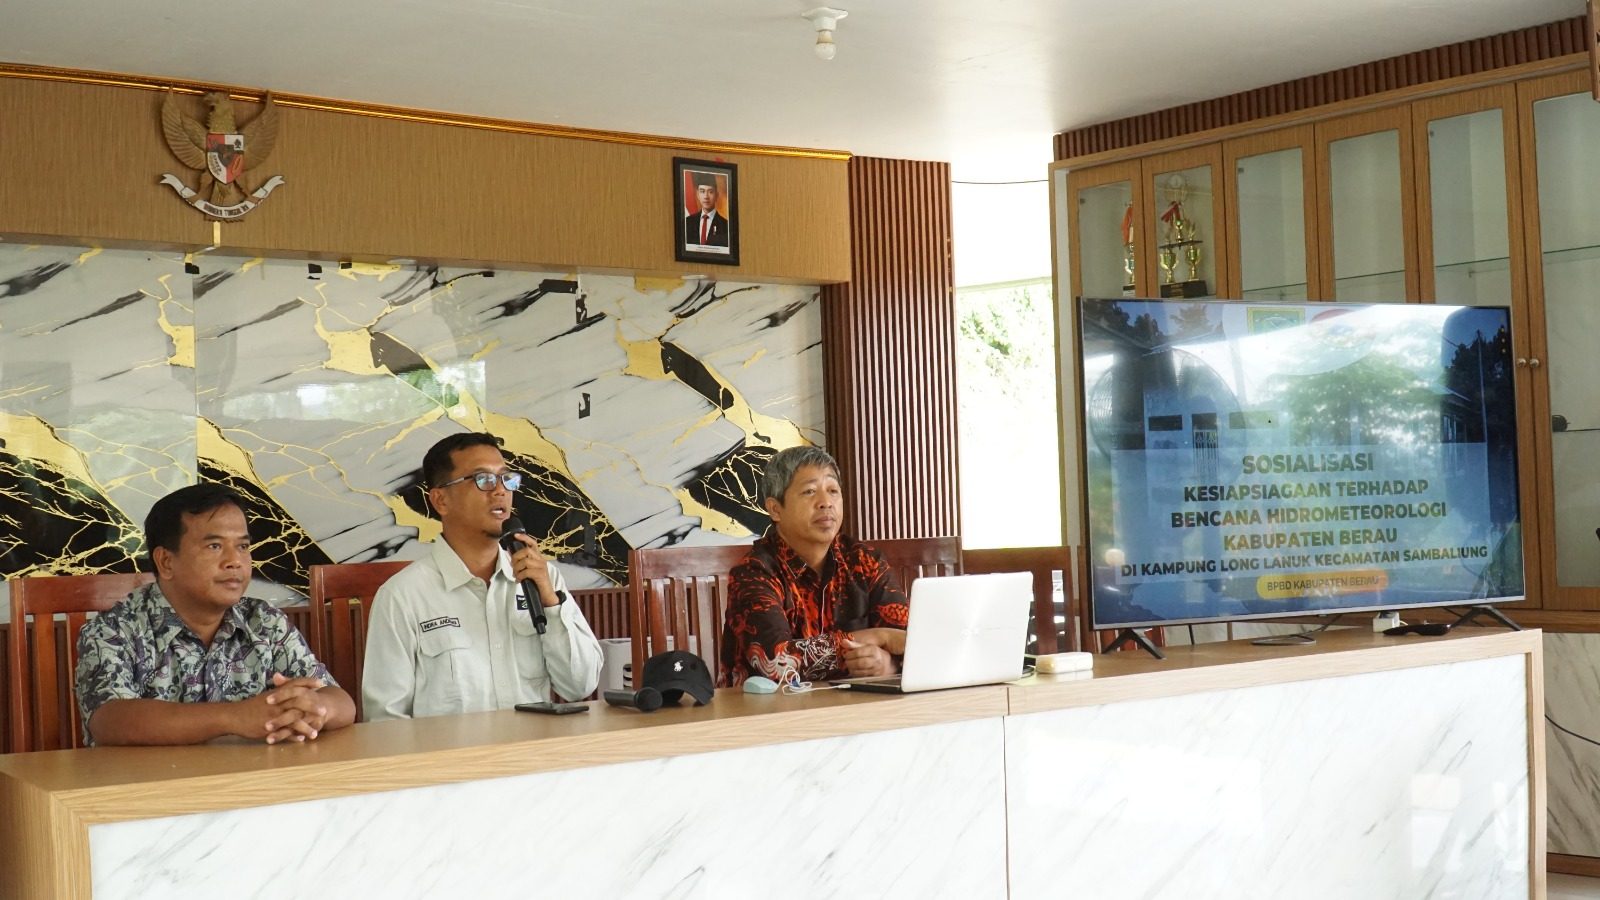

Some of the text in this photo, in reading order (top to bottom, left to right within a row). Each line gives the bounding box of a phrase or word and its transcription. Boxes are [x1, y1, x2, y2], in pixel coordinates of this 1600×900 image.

[1242, 453, 1373, 474] SOSIALISASI
[1184, 479, 1429, 502] KESIAPSIAGAAN TERHADAP
[1171, 501, 1447, 528] BENCANA HIDROMETEOROLOGI
[1223, 527, 1397, 551] KABUPATEN BERAU
[1121, 546, 1488, 577] DI KAMPUNG LONG LANUK KECAMATAN SAMBALIUNG
[1267, 579, 1292, 592] BPBD
[1294, 575, 1348, 590] KABUPATEN
